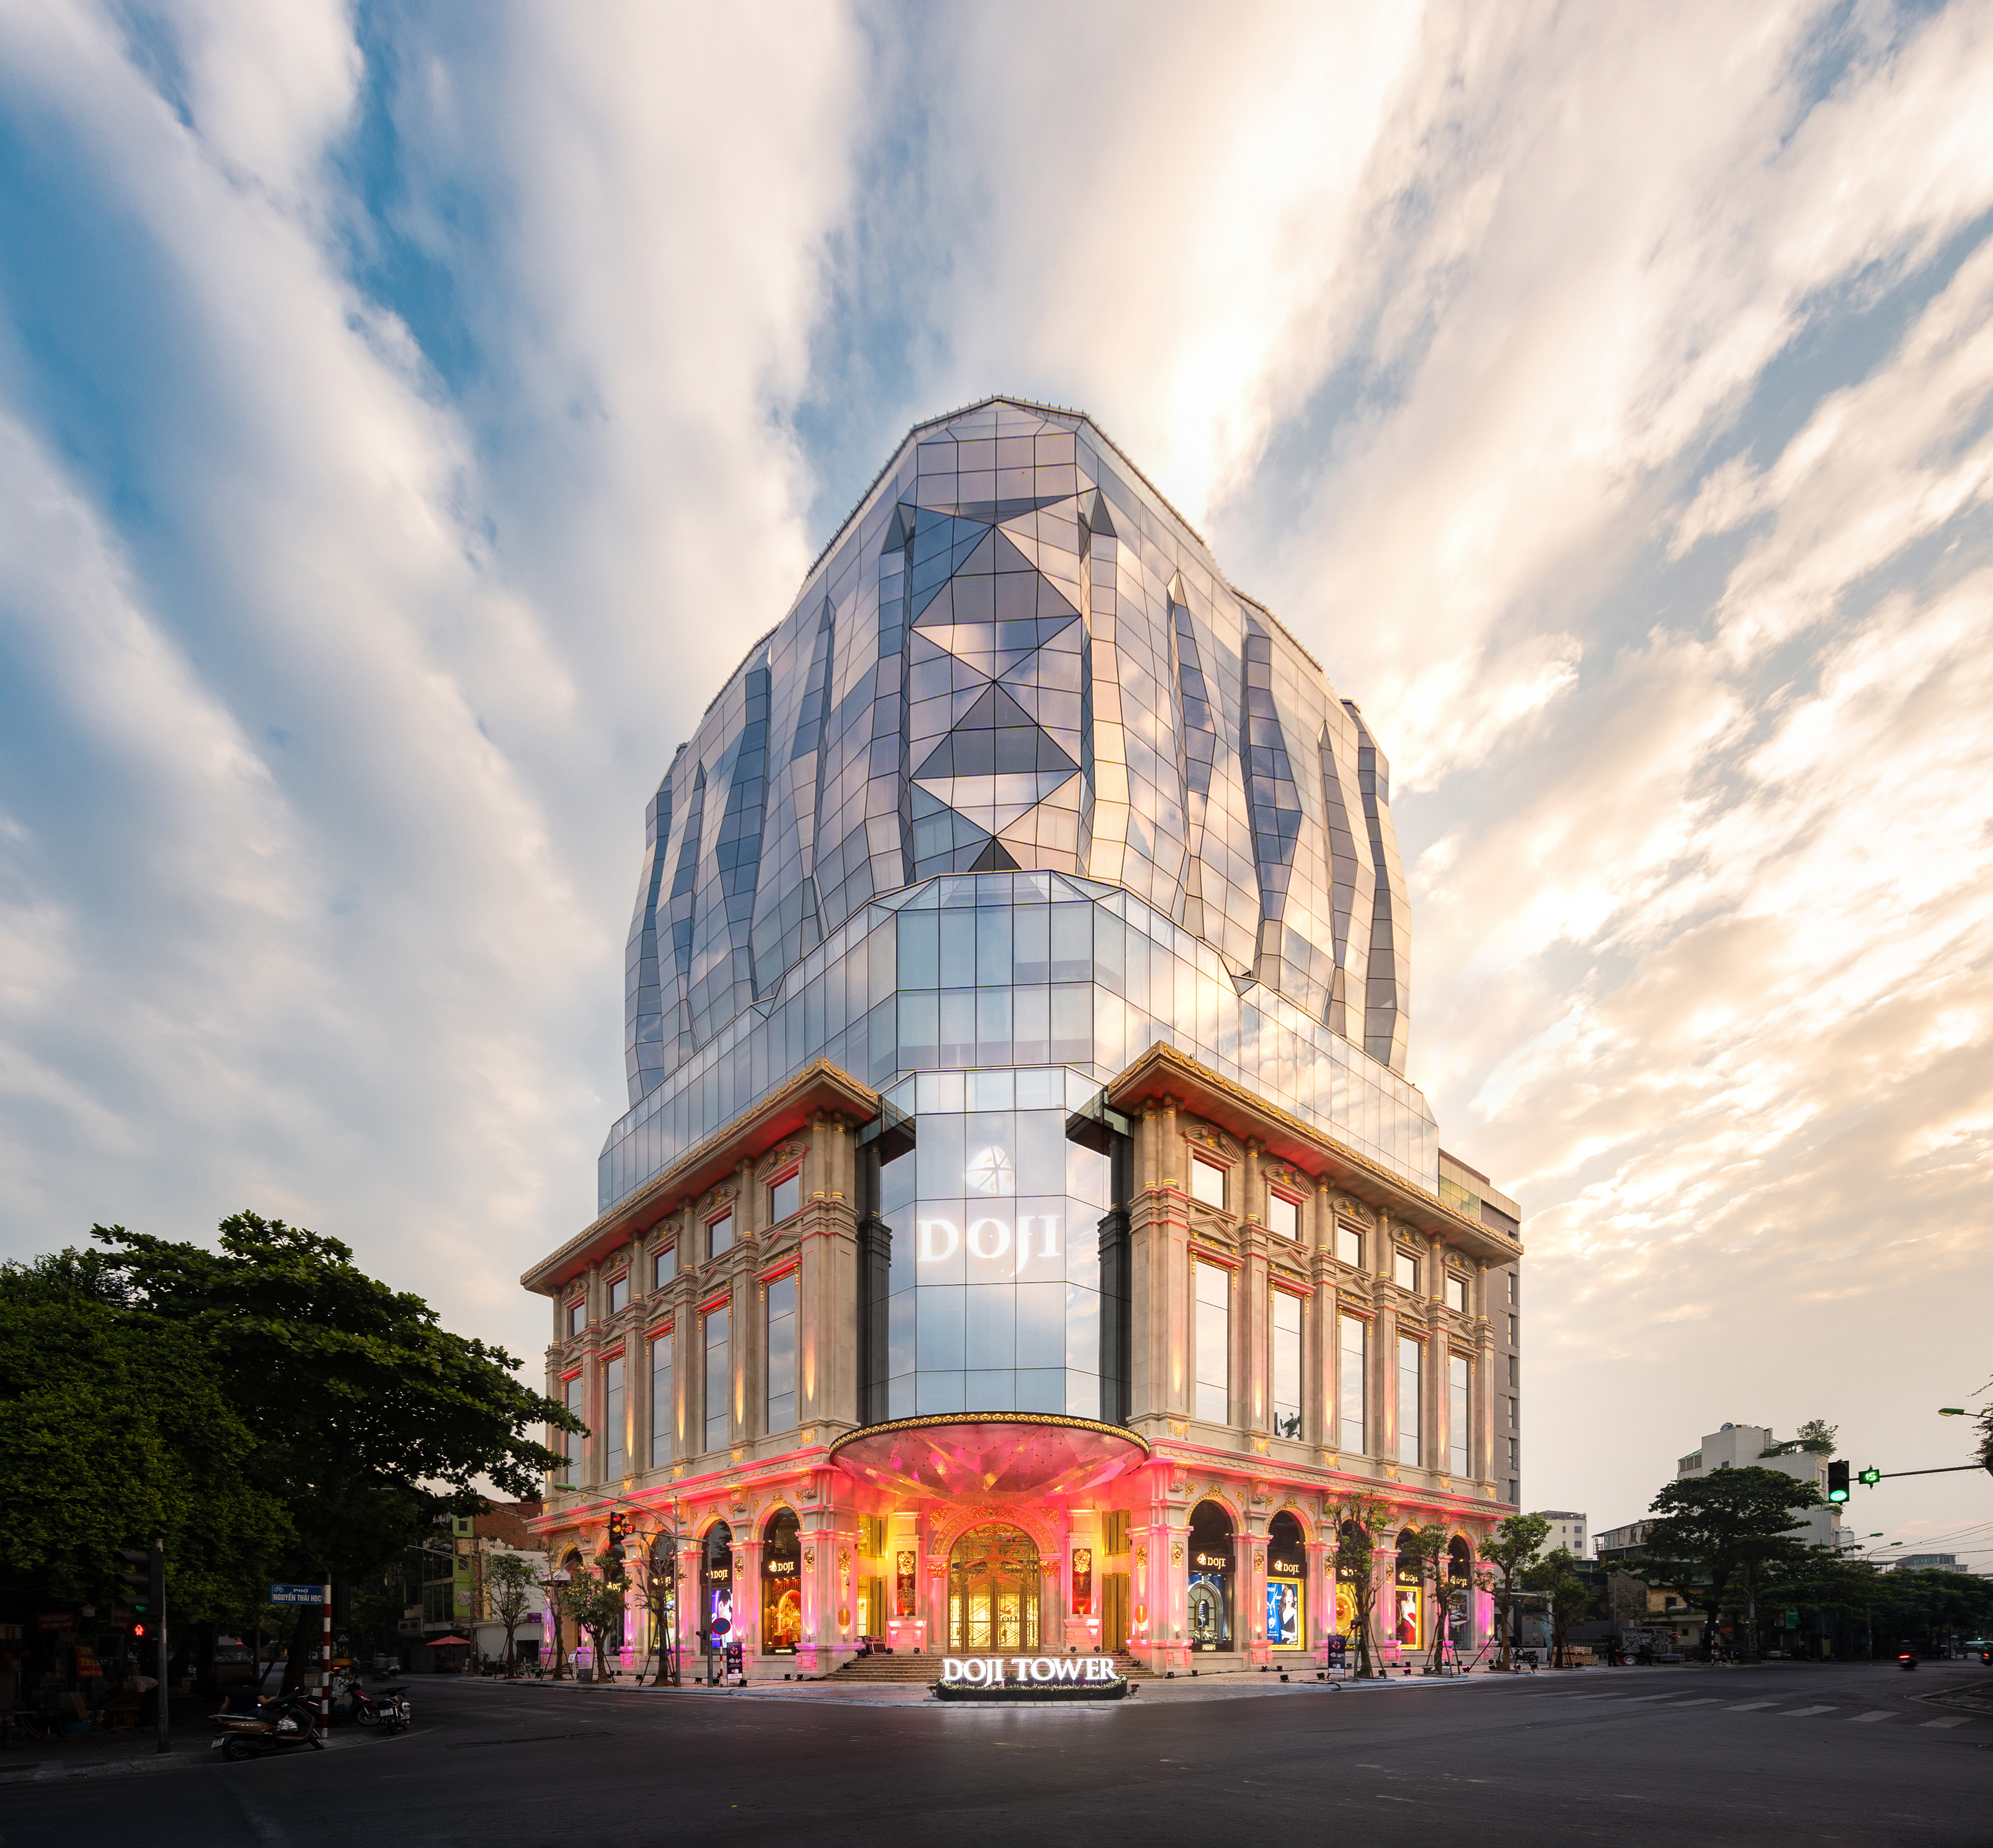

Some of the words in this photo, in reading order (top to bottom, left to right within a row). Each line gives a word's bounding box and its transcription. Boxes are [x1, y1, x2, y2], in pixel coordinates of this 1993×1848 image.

[917, 1215, 1063, 1277] DOJI
[1865, 1472, 1876, 1481] 15
[777, 1562, 794, 1574] DOJI
[1207, 1557, 1226, 1570] DOJI
[1283, 1563, 1300, 1575] DOJI
[713, 1570, 728, 1581] DOJI
[297, 1593, 310, 1602] THÁI
[943, 1659, 1005, 1687] DOJI
[1011, 1658, 1120, 1681] TOWER
